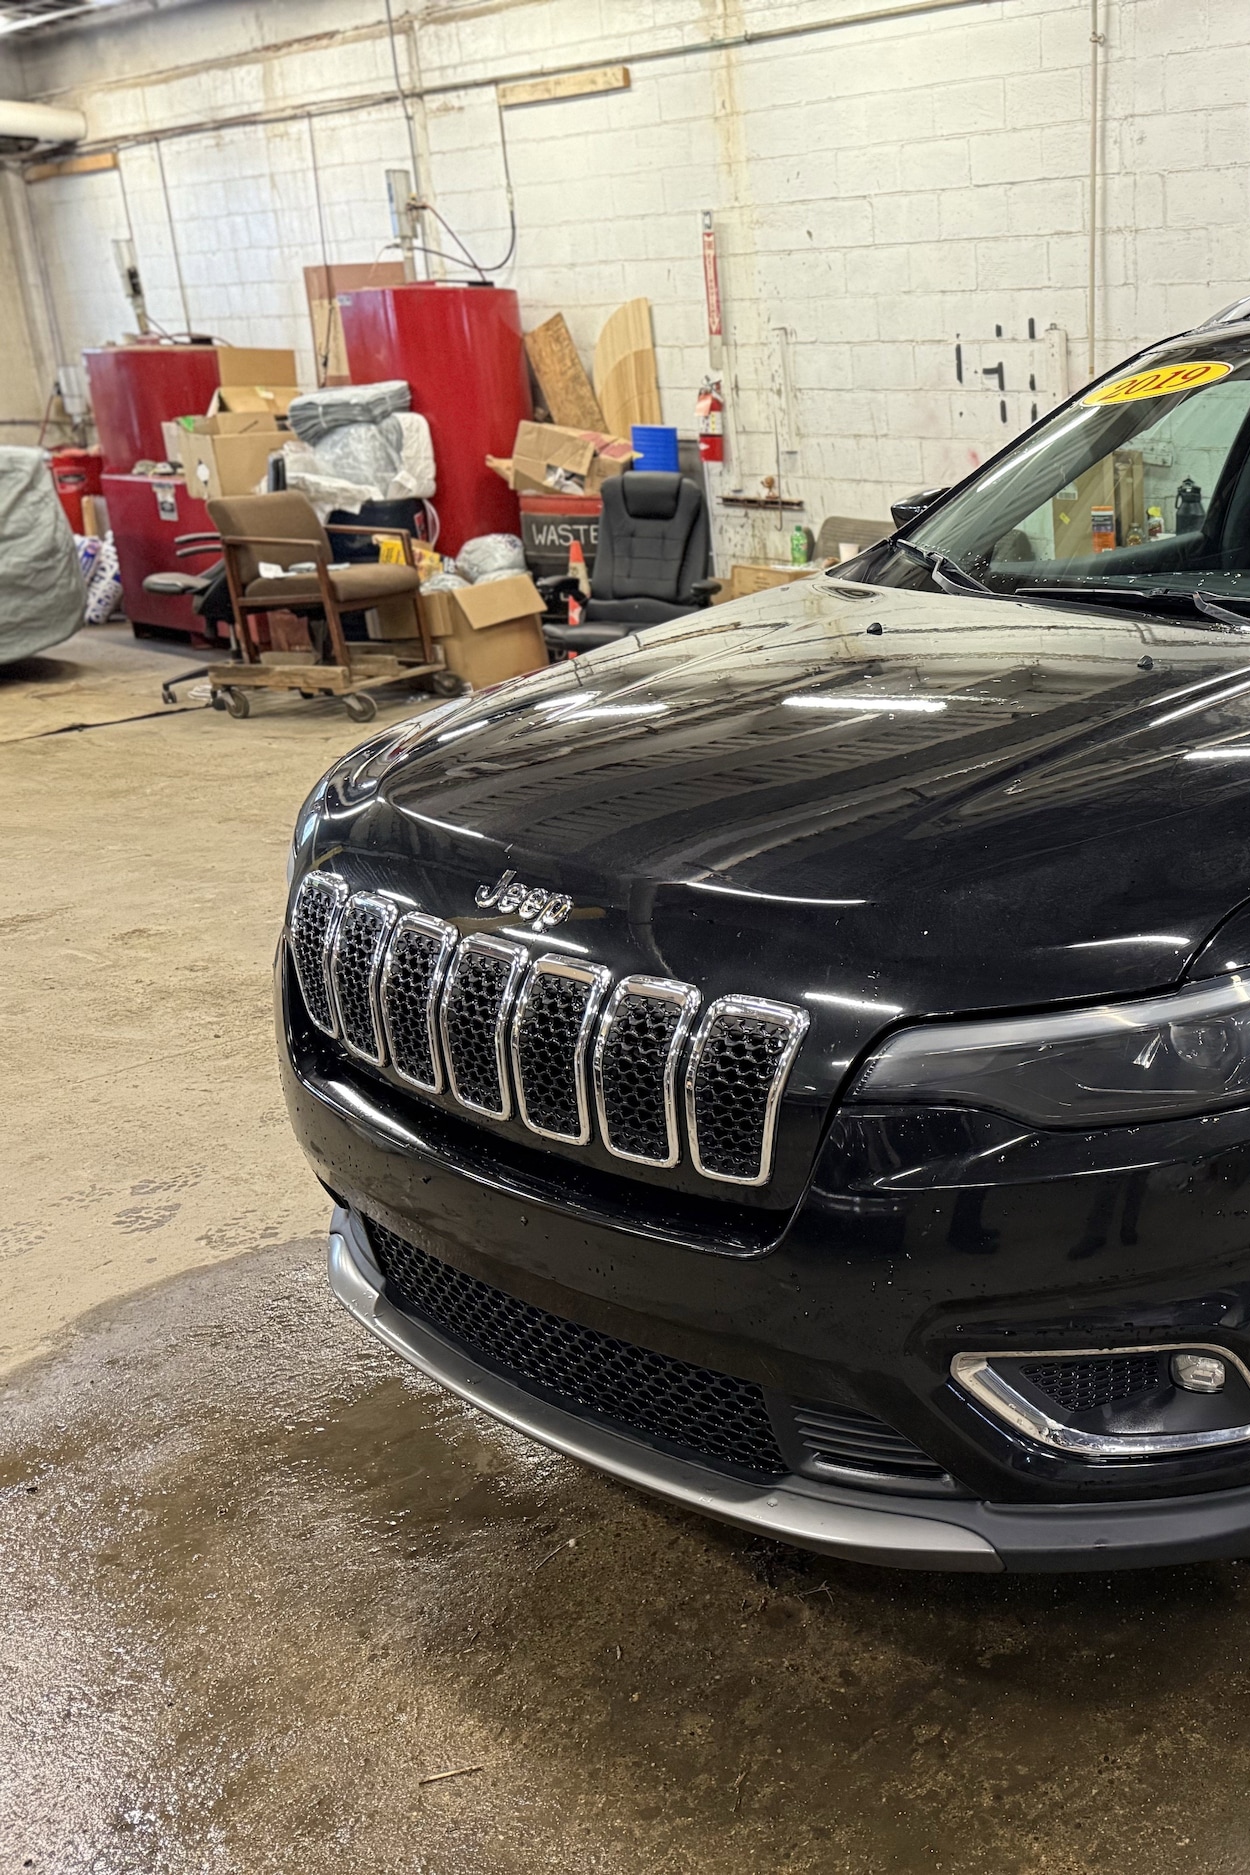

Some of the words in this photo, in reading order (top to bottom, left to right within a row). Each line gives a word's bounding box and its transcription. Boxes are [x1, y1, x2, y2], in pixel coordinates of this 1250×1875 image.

[1098, 366, 1212, 401] 2019
[531, 523, 599, 546] WASTE
[475, 869, 575, 932] Jeep
